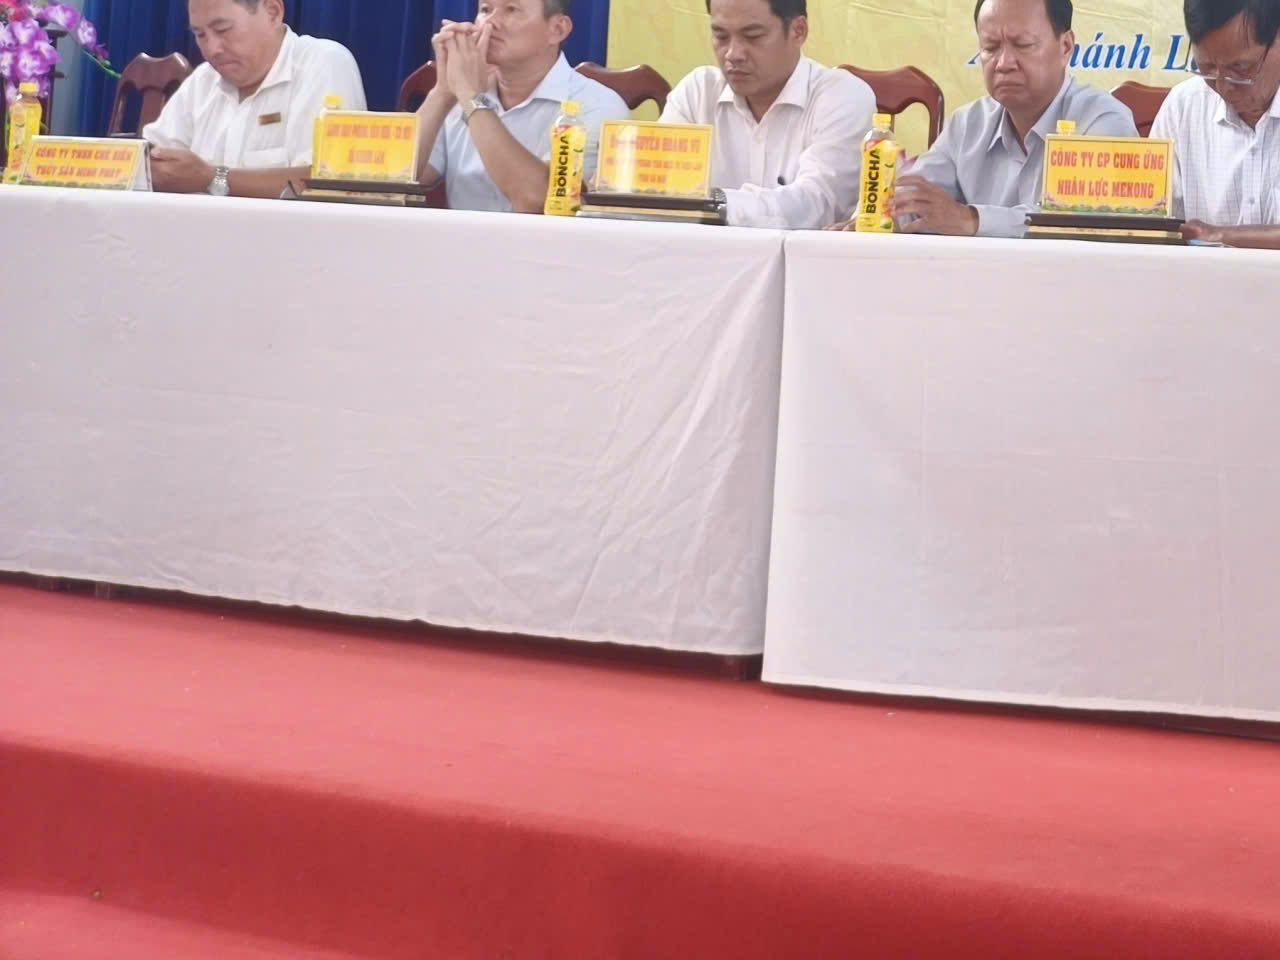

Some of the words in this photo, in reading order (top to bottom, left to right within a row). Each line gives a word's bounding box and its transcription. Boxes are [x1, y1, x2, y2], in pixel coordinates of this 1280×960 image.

[556, 136, 569, 197] BONCHA
[1050, 147, 1078, 167] CÔNG
[1080, 151, 1094, 168] TY
[1097, 152, 1110, 168] CP
[1113, 152, 1140, 169] CUNG
[1143, 149, 1164, 170] ỨNG
[866, 150, 881, 213] BONCHA
[1057, 176, 1085, 196] NHÂN
[1112, 181, 1154, 199] MEKONG
